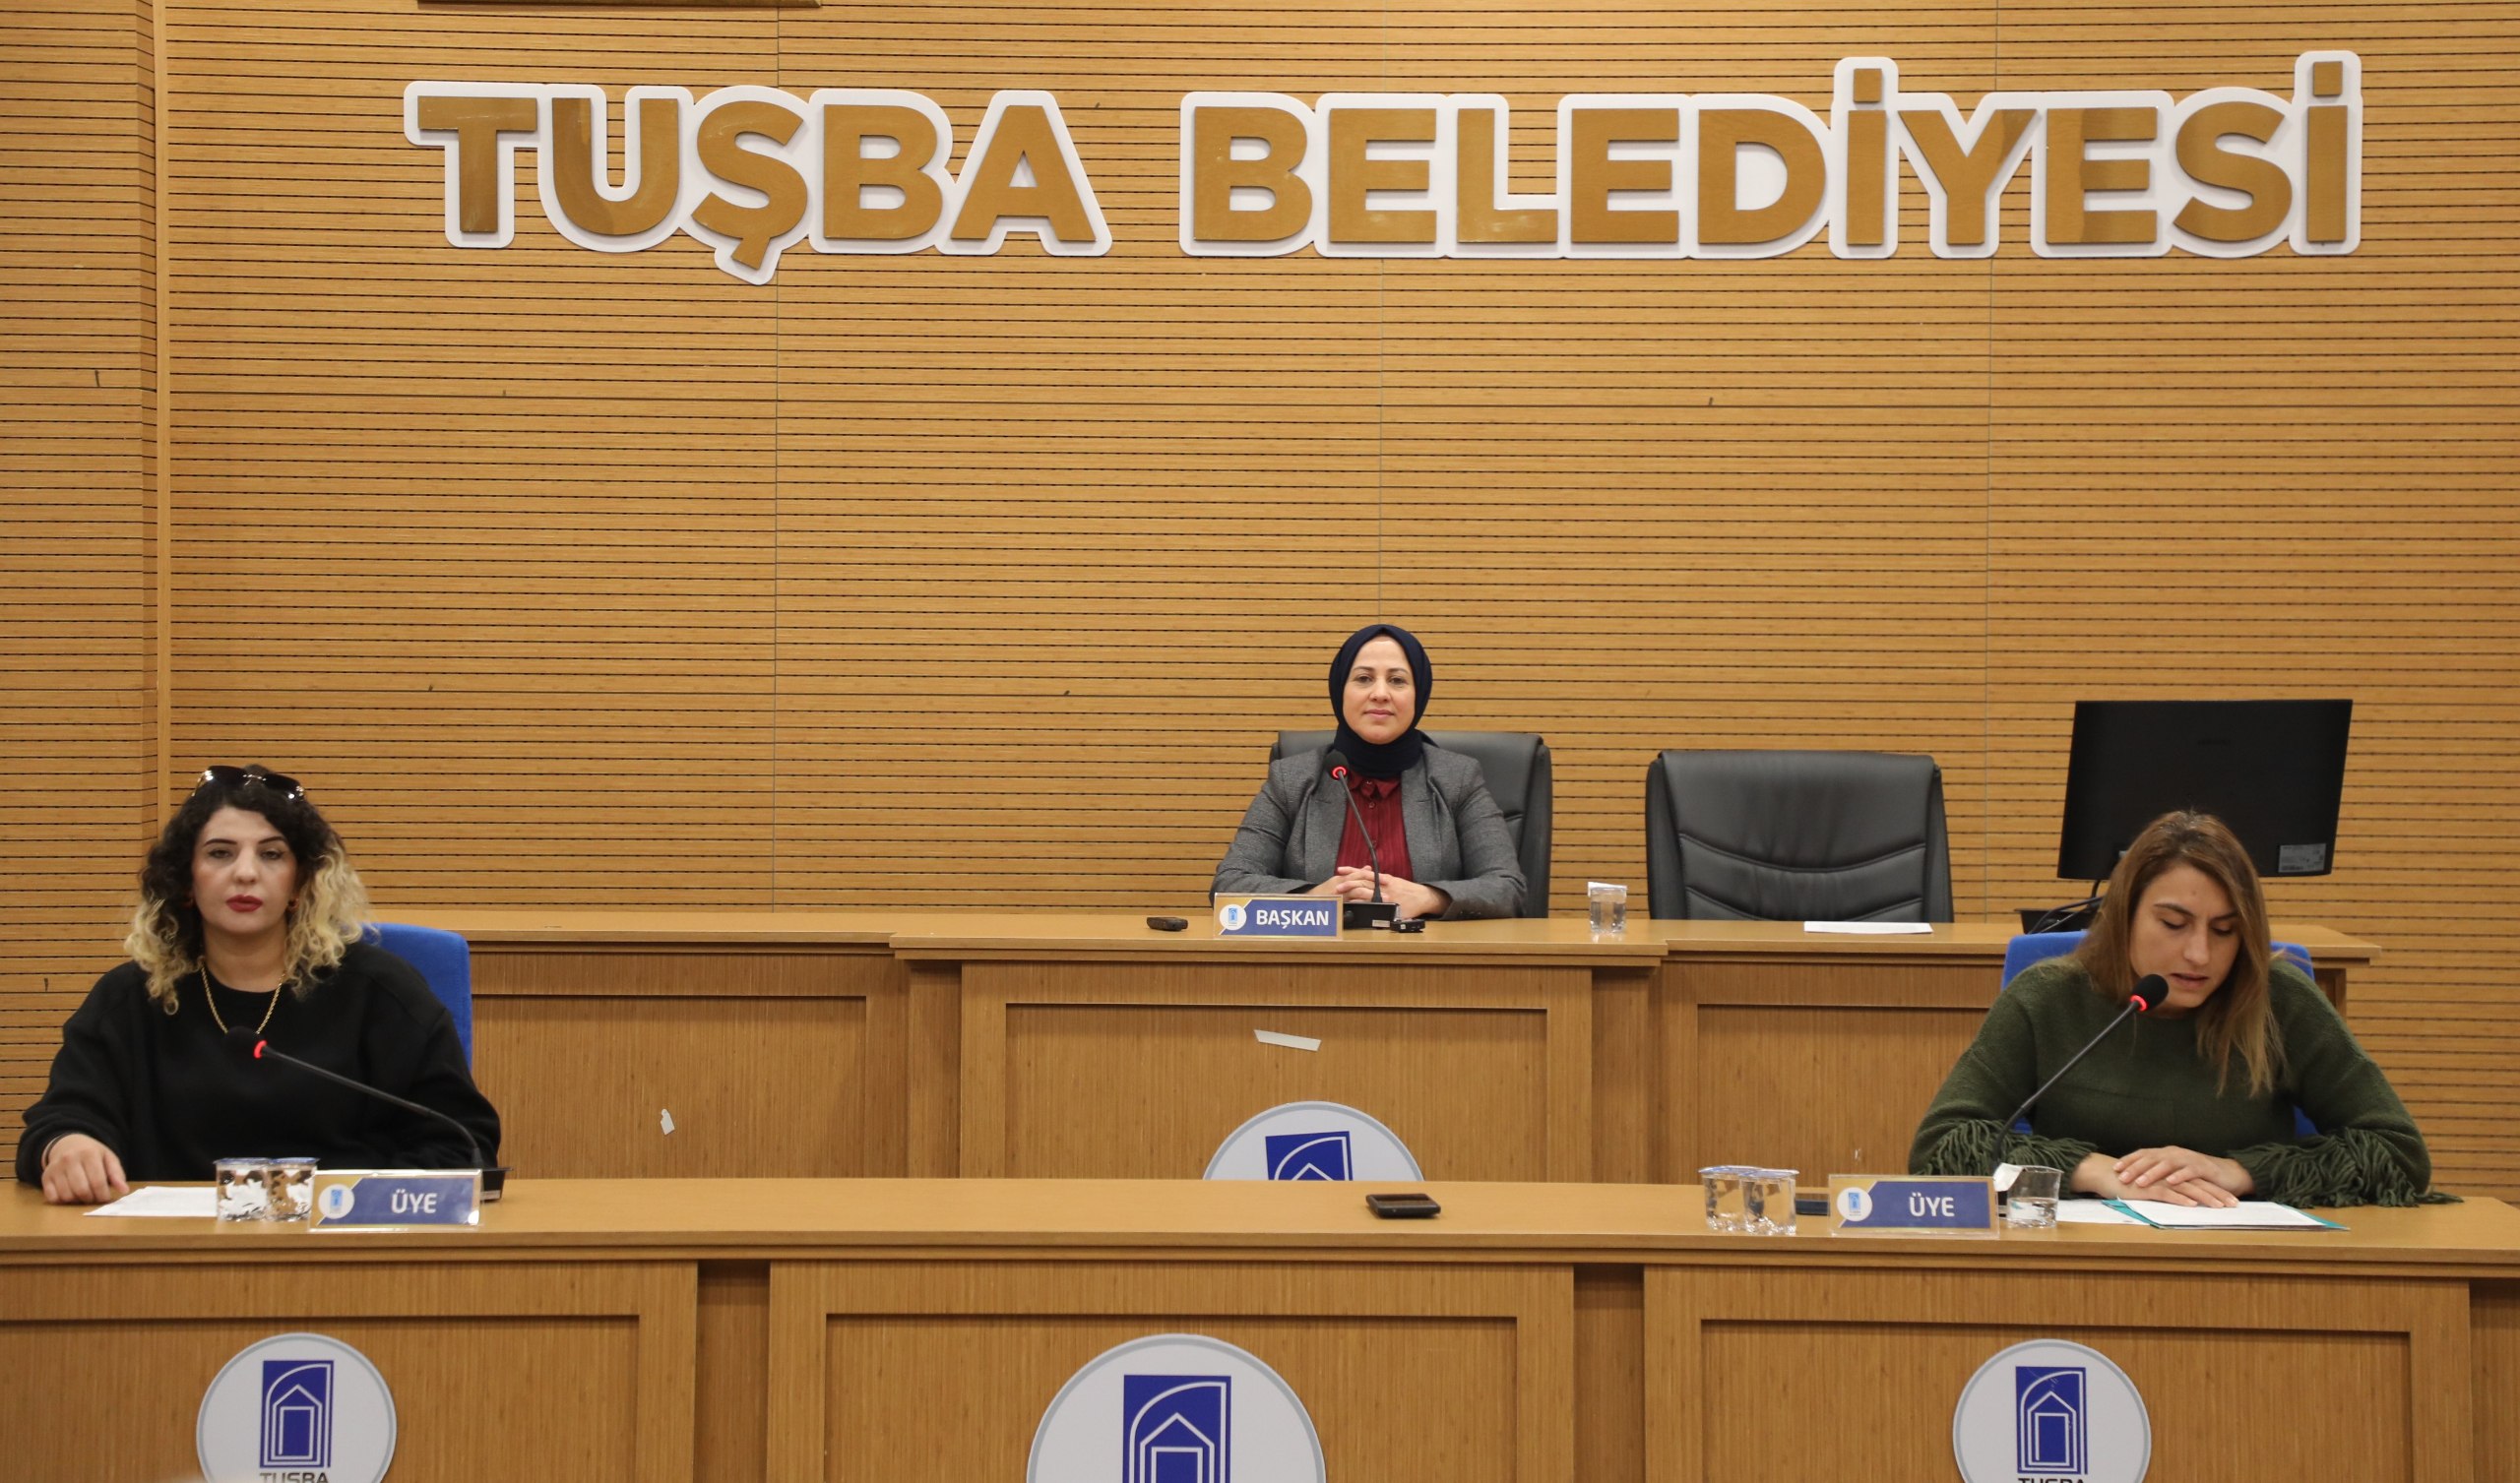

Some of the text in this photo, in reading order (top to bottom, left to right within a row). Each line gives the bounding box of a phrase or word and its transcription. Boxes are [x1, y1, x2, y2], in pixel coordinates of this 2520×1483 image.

[415, 60, 2349, 271] TUŞBA BELEDİYESİ
[1256, 909, 1329, 929] BAŞKAN
[391, 1189, 437, 1213] ÜYE
[1909, 1192, 1955, 1217] ÜYE
